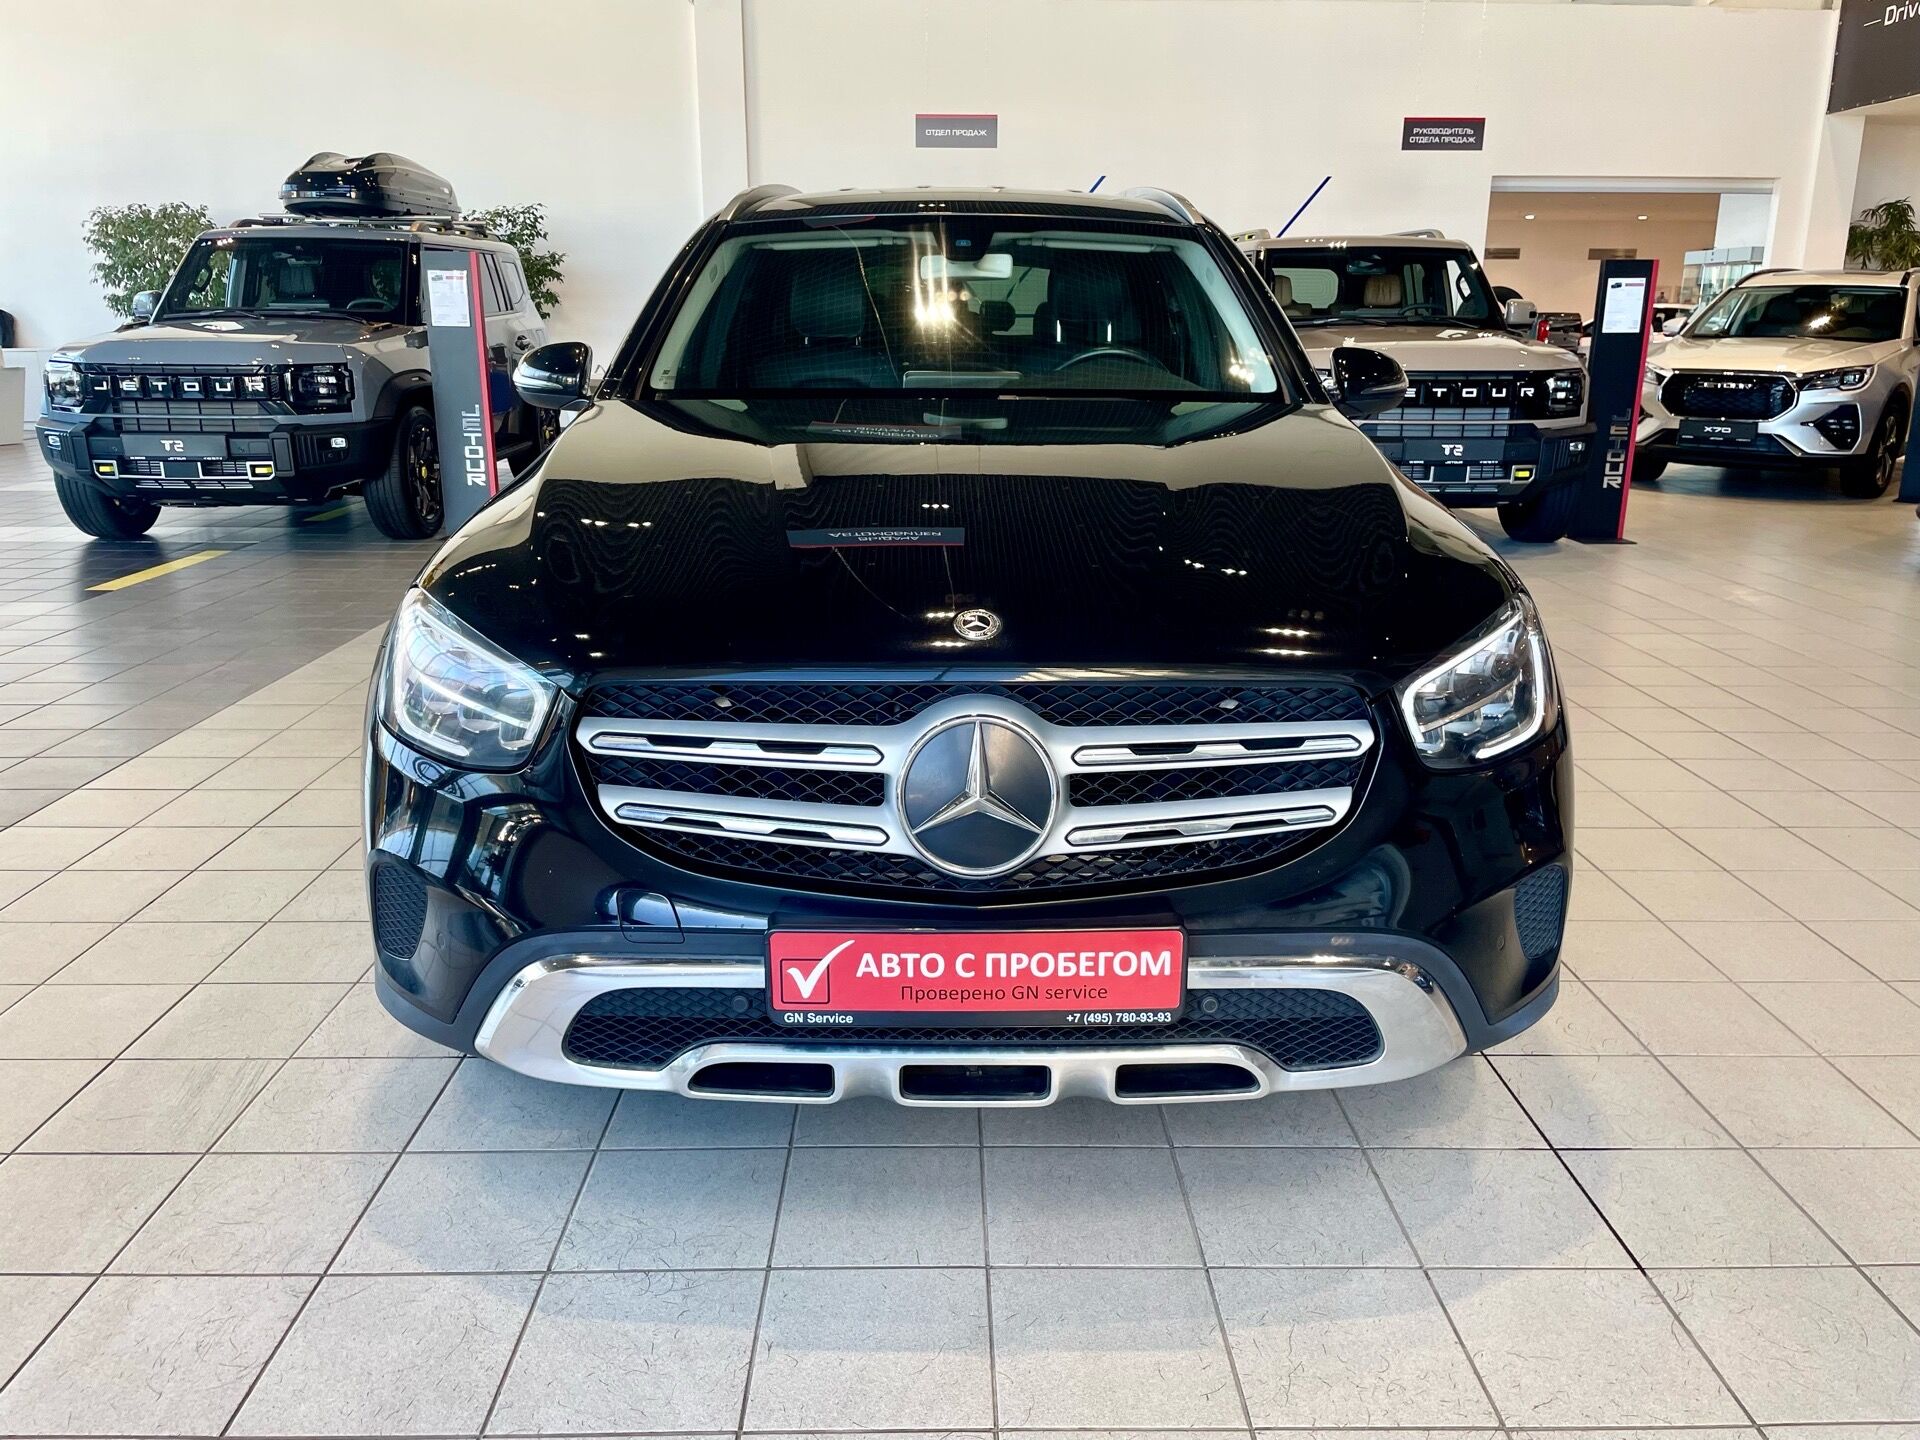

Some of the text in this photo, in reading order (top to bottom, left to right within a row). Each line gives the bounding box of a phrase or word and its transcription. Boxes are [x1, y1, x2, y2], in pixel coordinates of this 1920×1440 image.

[93, 381, 264, 392] JETOUR
[1404, 387, 1535, 398] ETOUR
[1704, 426, 1732, 434] X70
[160, 439, 184, 452] T2
[461, 404, 486, 487] JETOUR
[1441, 444, 1464, 456] T2
[1602, 408, 1631, 489] JETOUR
[855, 950, 1172, 979] АВТО С ПРОБЕГОМ
[901, 984, 1108, 1004] Проверено GN service
[784, 1012, 854, 1025] GN Service
[1066, 1012, 1172, 1025] +7 (495) 780-93-93
